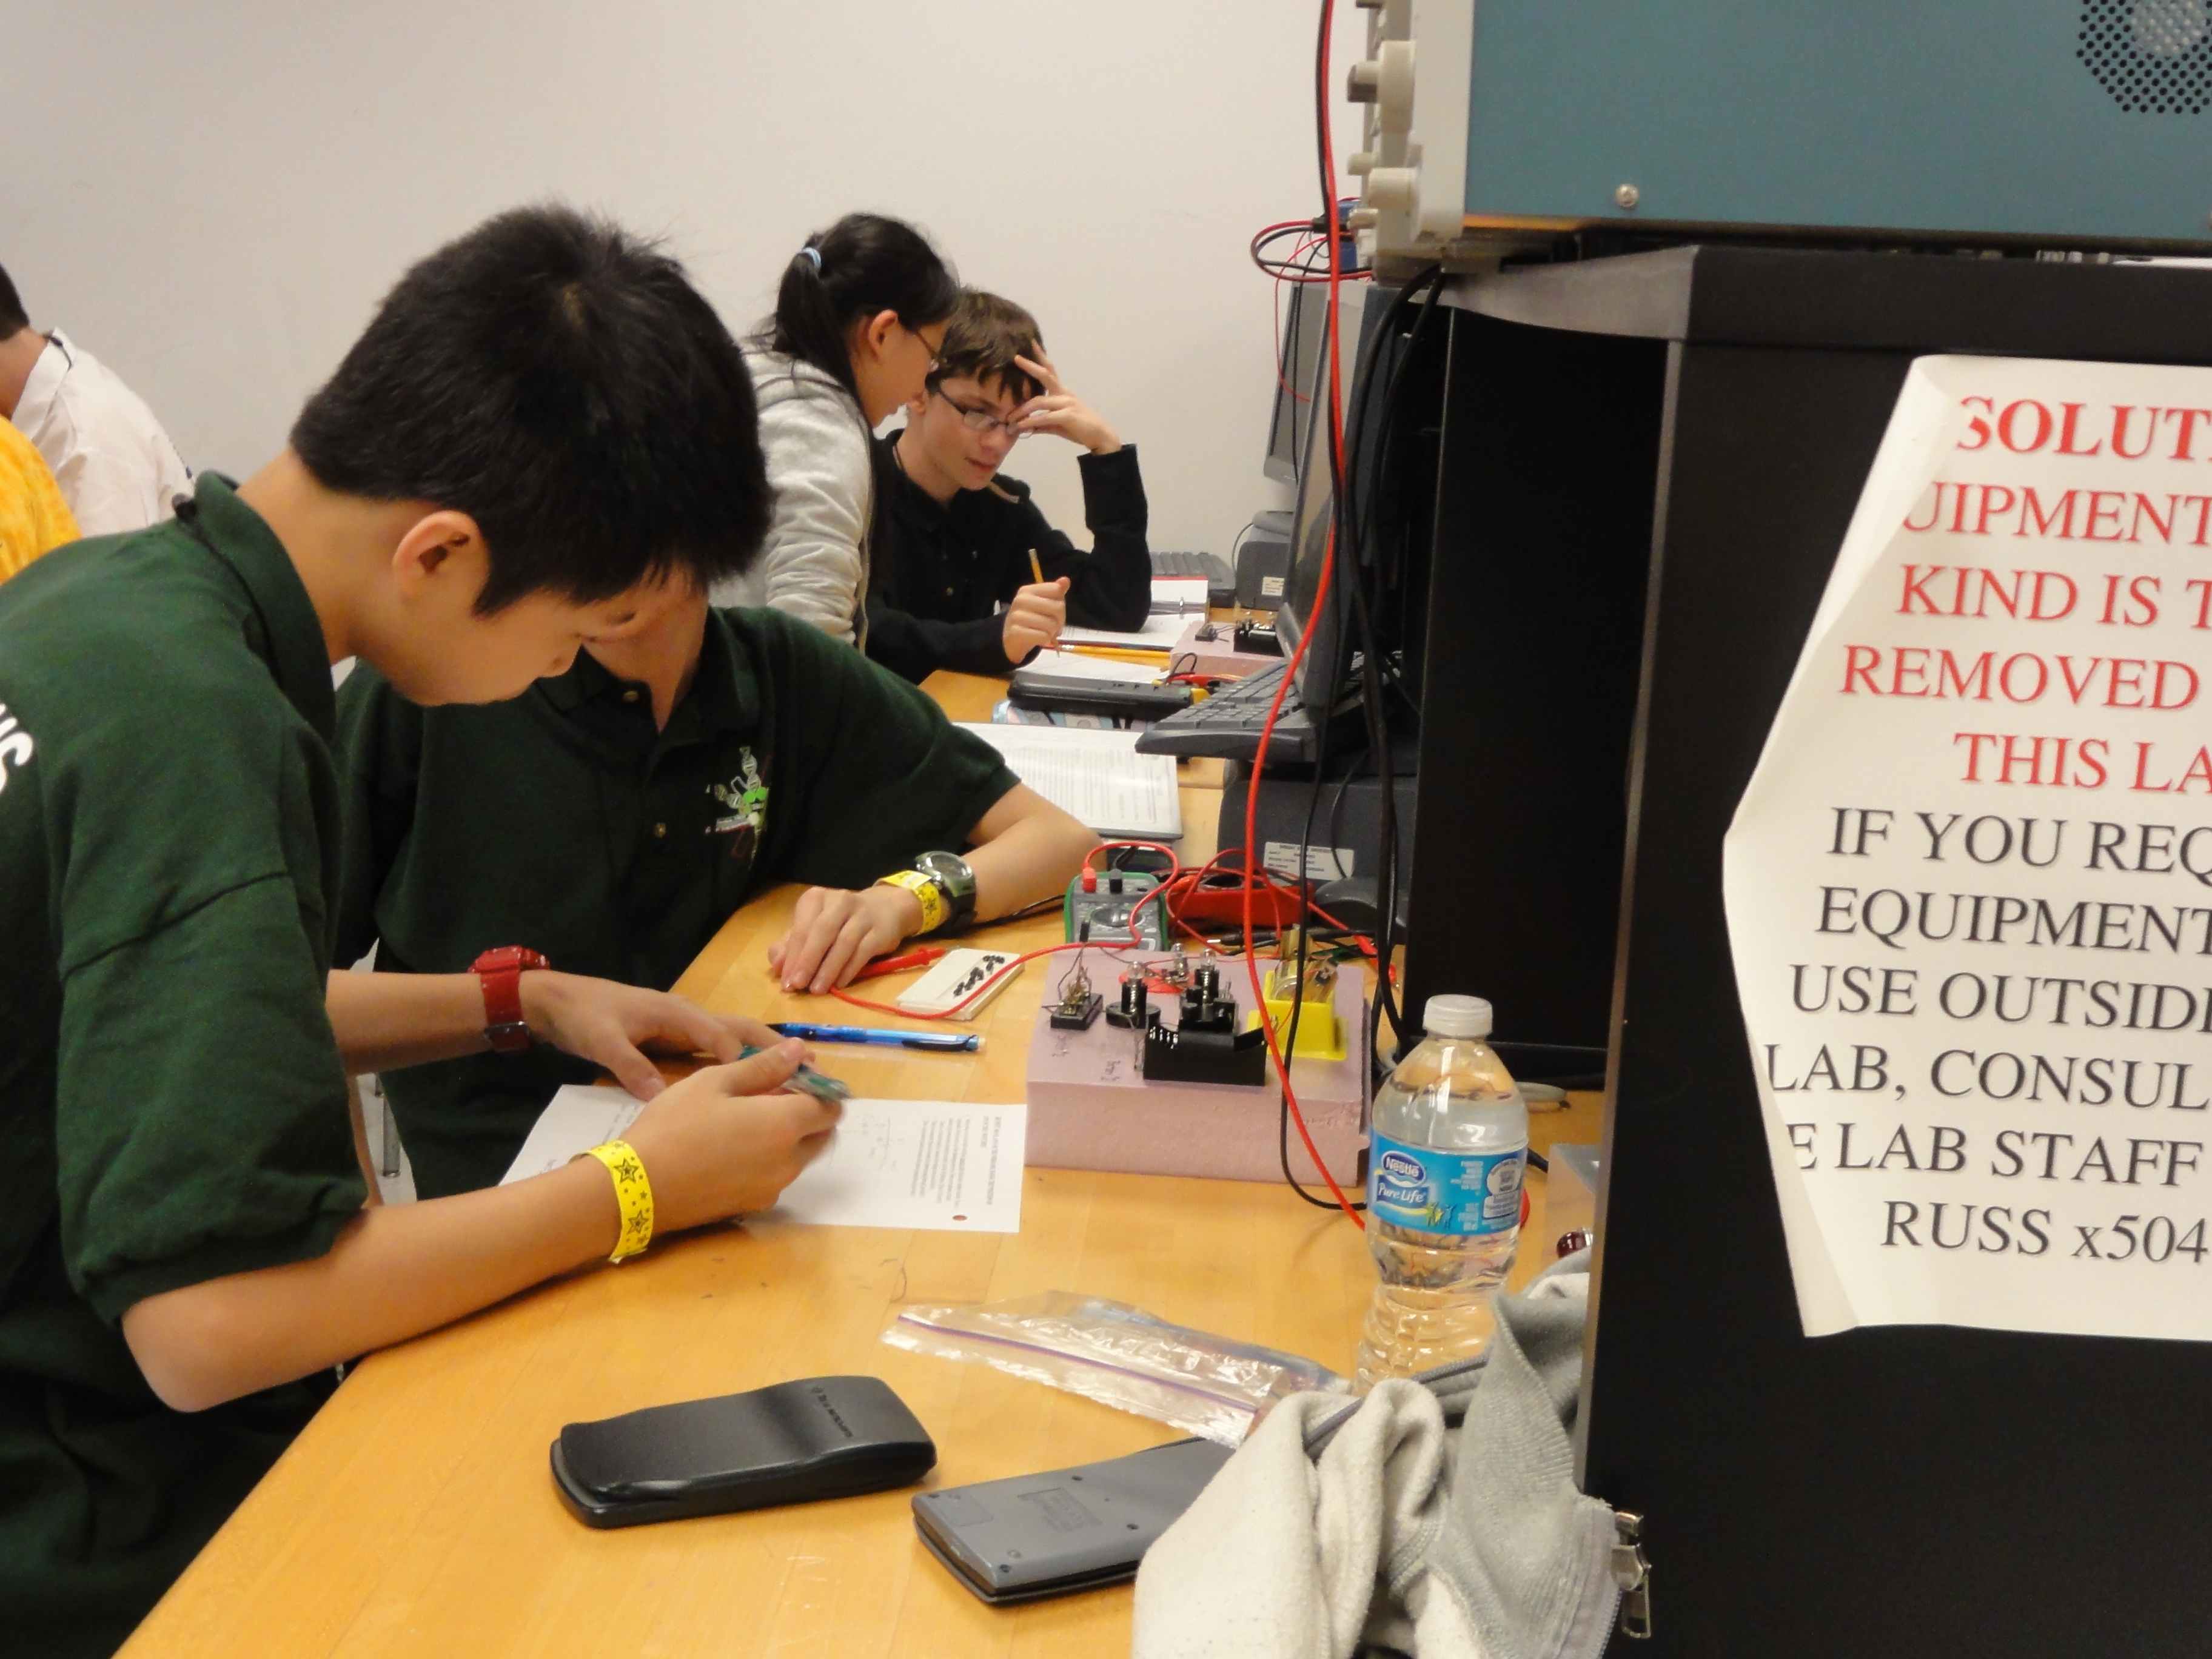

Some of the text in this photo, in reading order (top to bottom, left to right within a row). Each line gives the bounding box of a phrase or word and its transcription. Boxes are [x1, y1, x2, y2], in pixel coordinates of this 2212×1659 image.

[1956, 395, 2212, 461] SOLUT
[1897, 563, 2079, 621] KIND
[2097, 574, 2161, 628] IS
[1840, 644, 2200, 710] REMOVED
[1953, 732, 2212, 796] THIS LA
[1827, 806, 2212, 888] IF YOU REQ
[1815, 885, 2212, 956] EQUIPMENT
[1789, 964, 1919, 1016] USE
[1766, 1043, 2210, 1111] LAB, CONSUL
[1834, 1122, 1967, 1173] LAB
[1991, 1129, 2204, 1187] STAFF
[1378, 1182, 1424, 1204] Pure Life
[1880, 1200, 2209, 1264] RUSS x504
